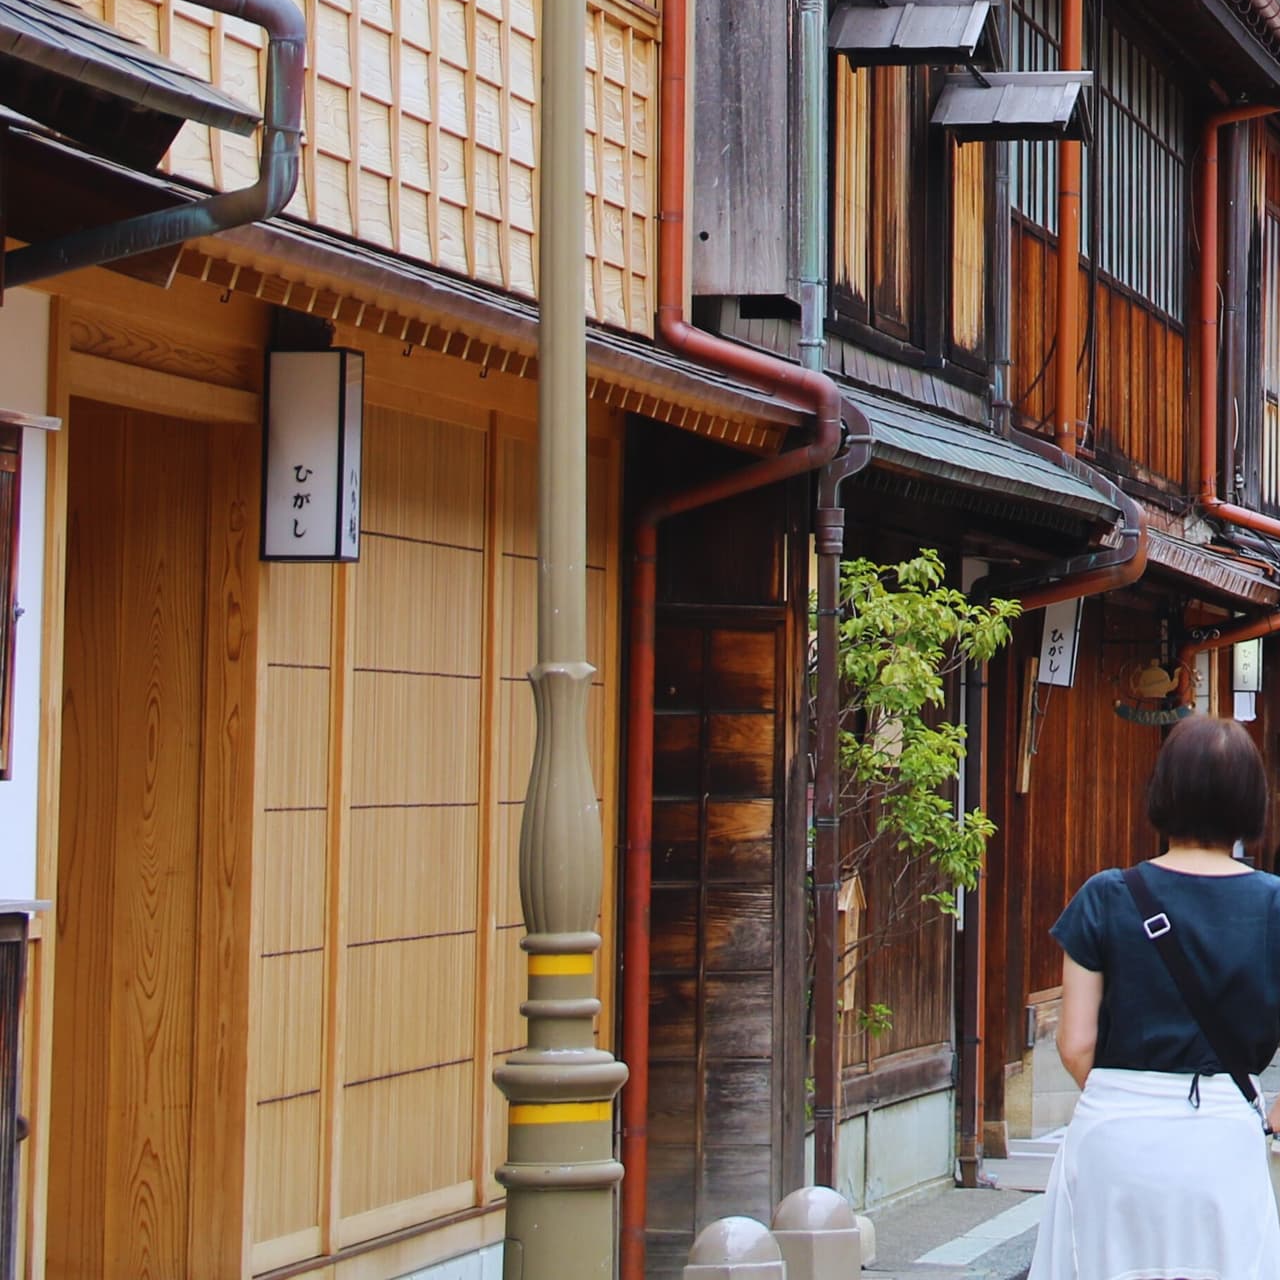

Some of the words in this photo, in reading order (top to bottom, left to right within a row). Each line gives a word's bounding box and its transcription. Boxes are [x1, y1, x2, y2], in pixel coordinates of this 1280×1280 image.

[293, 464, 313, 538] ひがし
[1048, 628, 1064, 673] ひがし
[1242, 648, 1252, 685] ひがし
